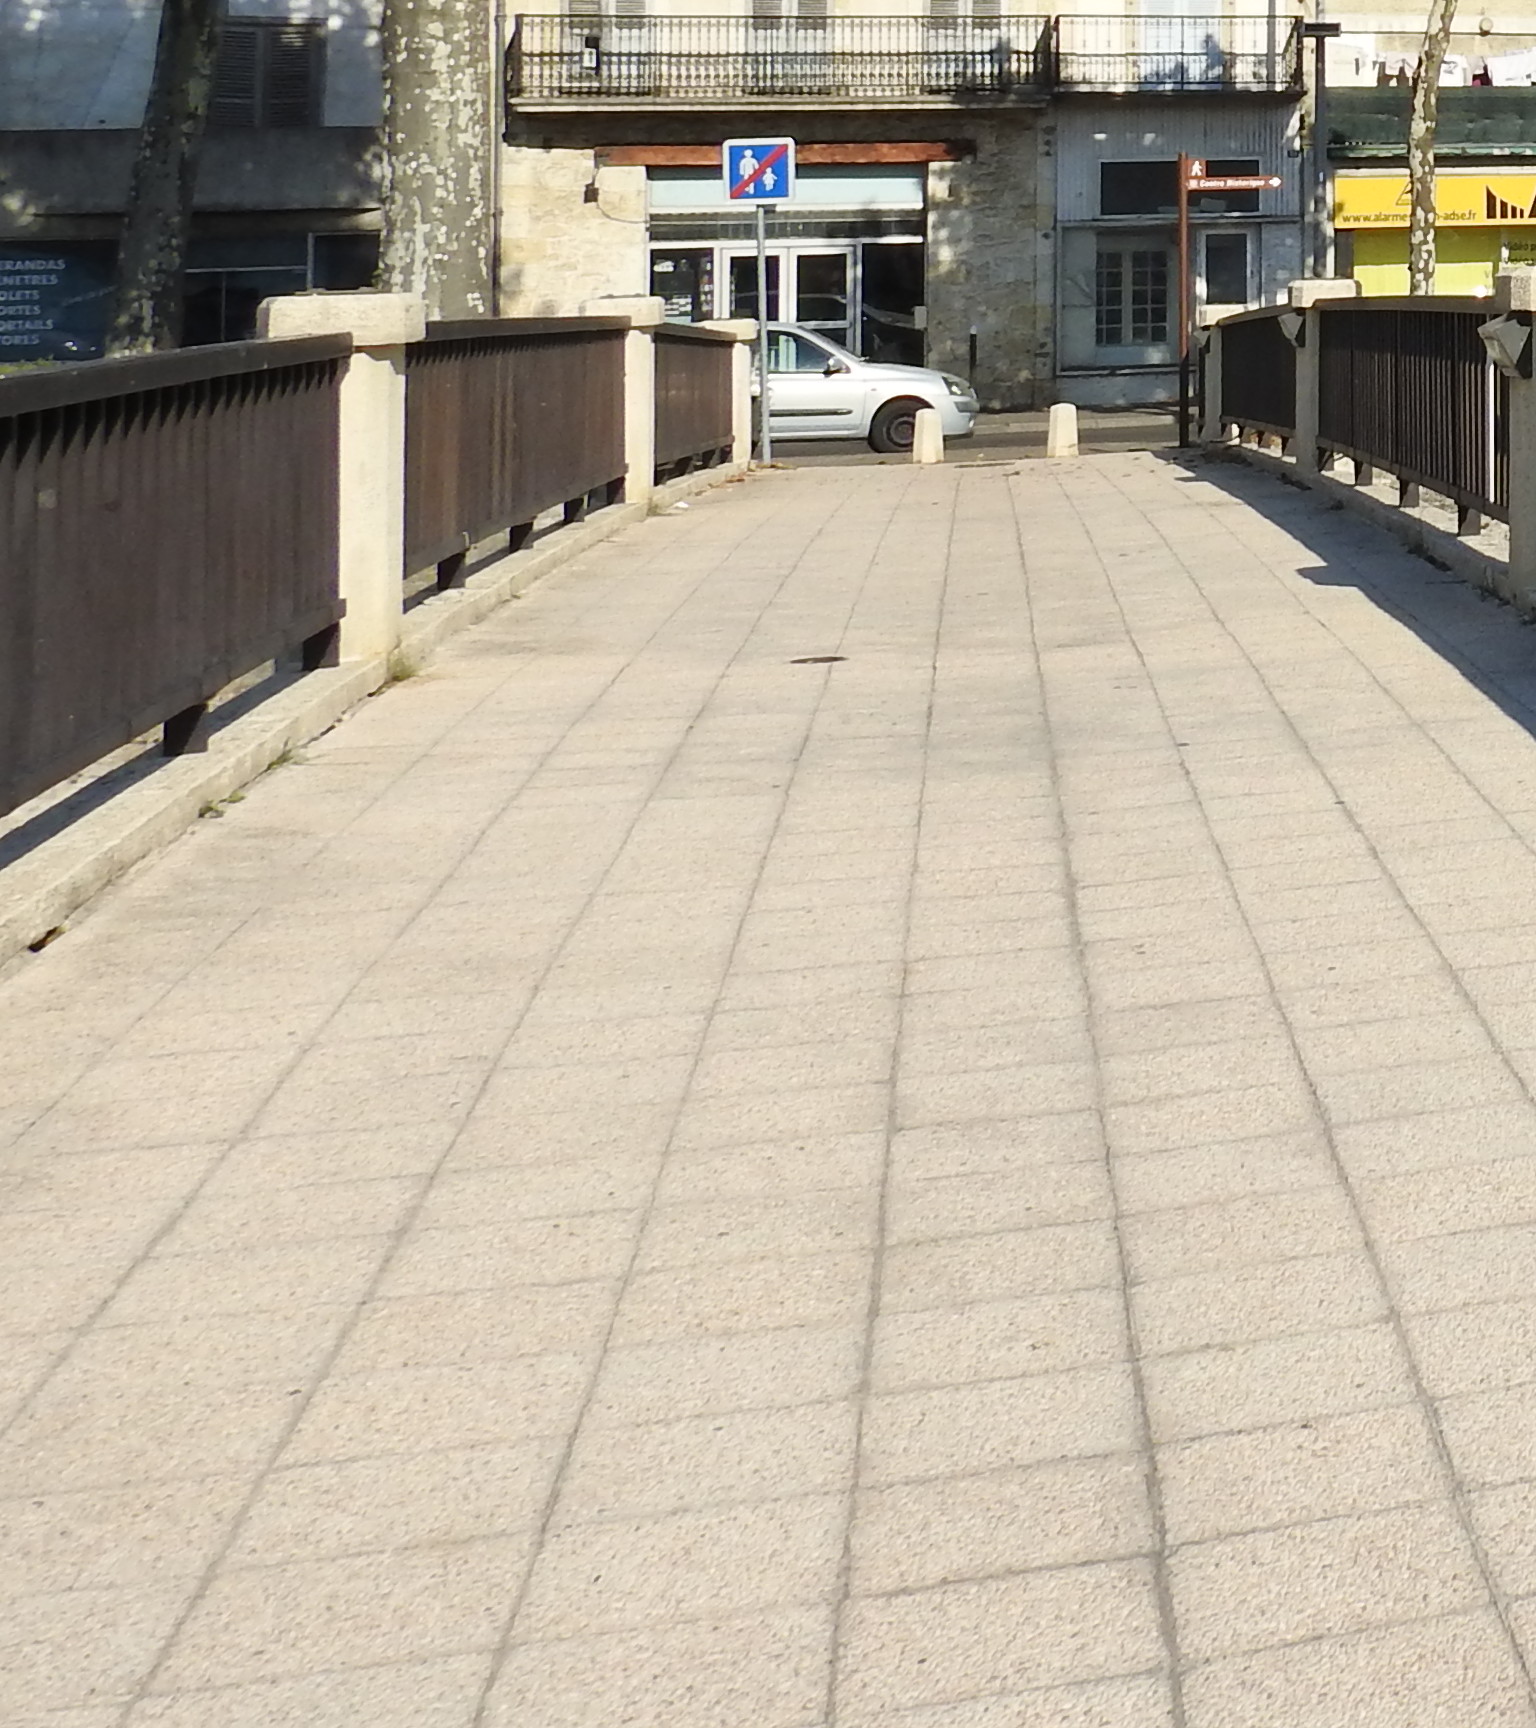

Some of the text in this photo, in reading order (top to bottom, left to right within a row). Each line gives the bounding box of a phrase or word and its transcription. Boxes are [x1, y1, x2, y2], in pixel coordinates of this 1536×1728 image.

[0, 259, 65, 270] ERANDAS
[0, 290, 40, 301] OLETS
[0, 305, 41, 316] ORTES
[0, 319, 54, 331] ORTAILS
